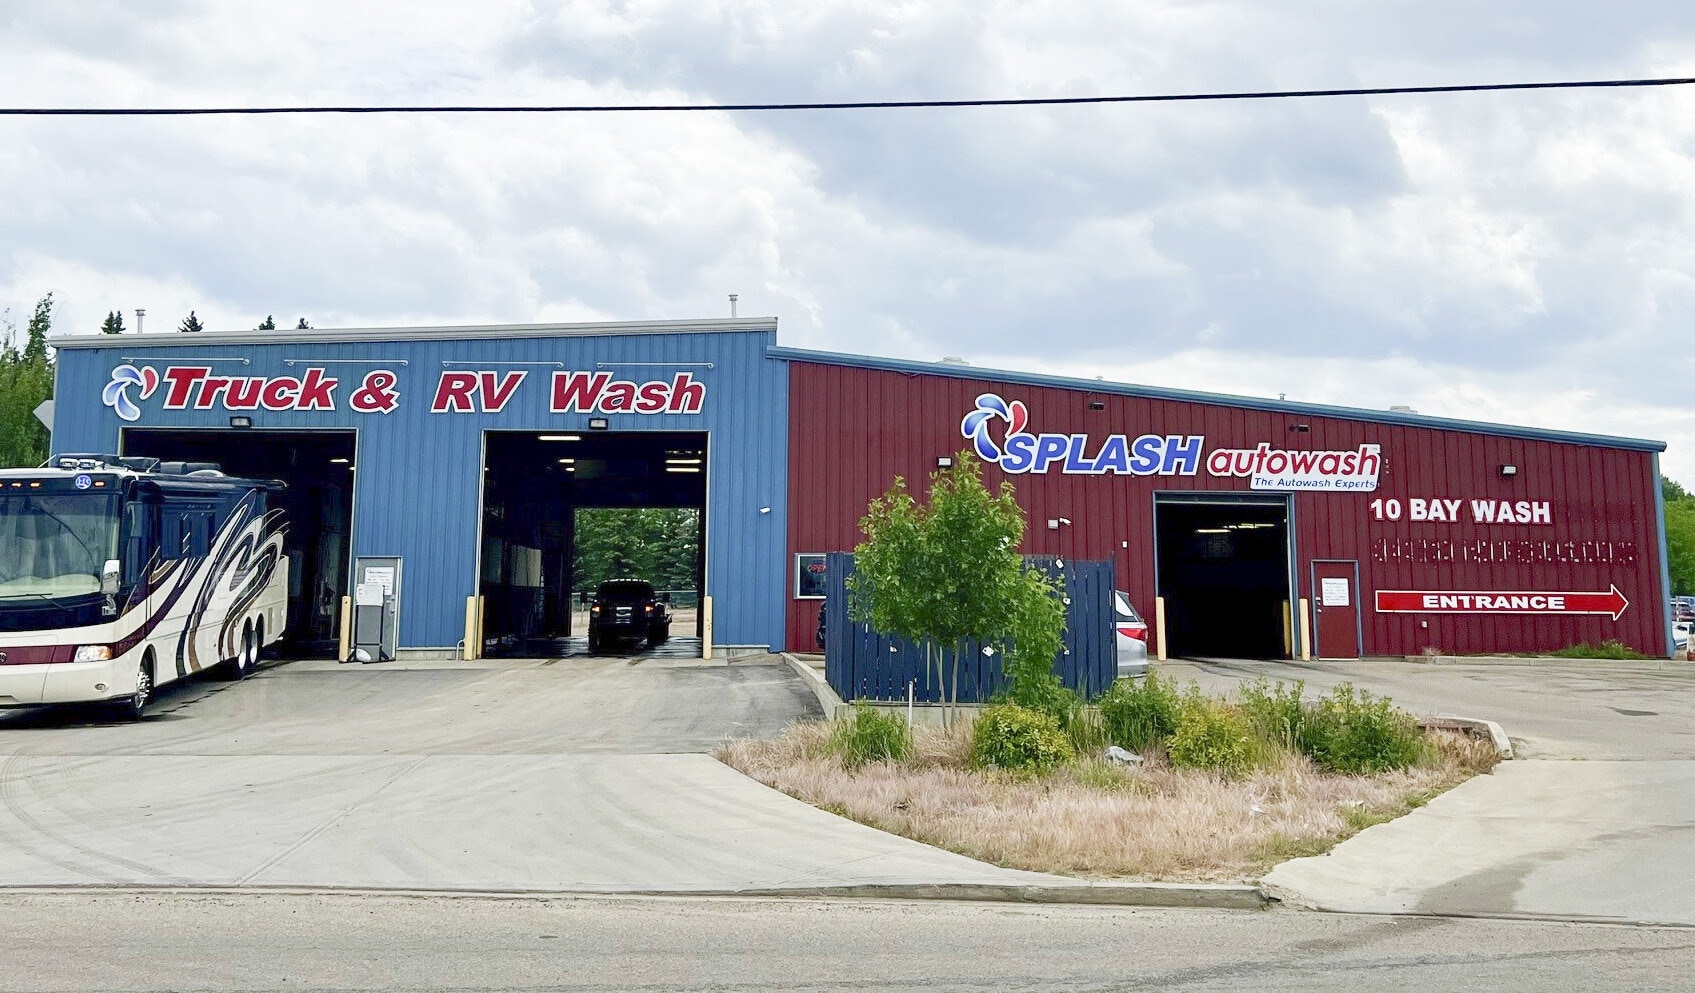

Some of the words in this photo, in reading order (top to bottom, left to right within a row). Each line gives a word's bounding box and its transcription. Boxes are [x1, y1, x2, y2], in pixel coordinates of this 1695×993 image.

[163, 366, 338, 410] Truck
[350, 370, 400, 414] &
[431, 371, 528, 412] RV
[550, 371, 706, 413] Wash
[1000, 433, 1204, 475] SPLASH
[1206, 444, 1380, 477] autowash
[1255, 477, 1274, 486] The
[1277, 478, 1331, 488] Autowash
[1335, 479, 1375, 489] Experts
[1370, 498, 1401, 520] 10
[1410, 498, 1461, 523] BAY
[1471, 500, 1551, 525] WASH
[1422, 595, 1566, 610] ENTRANCE
